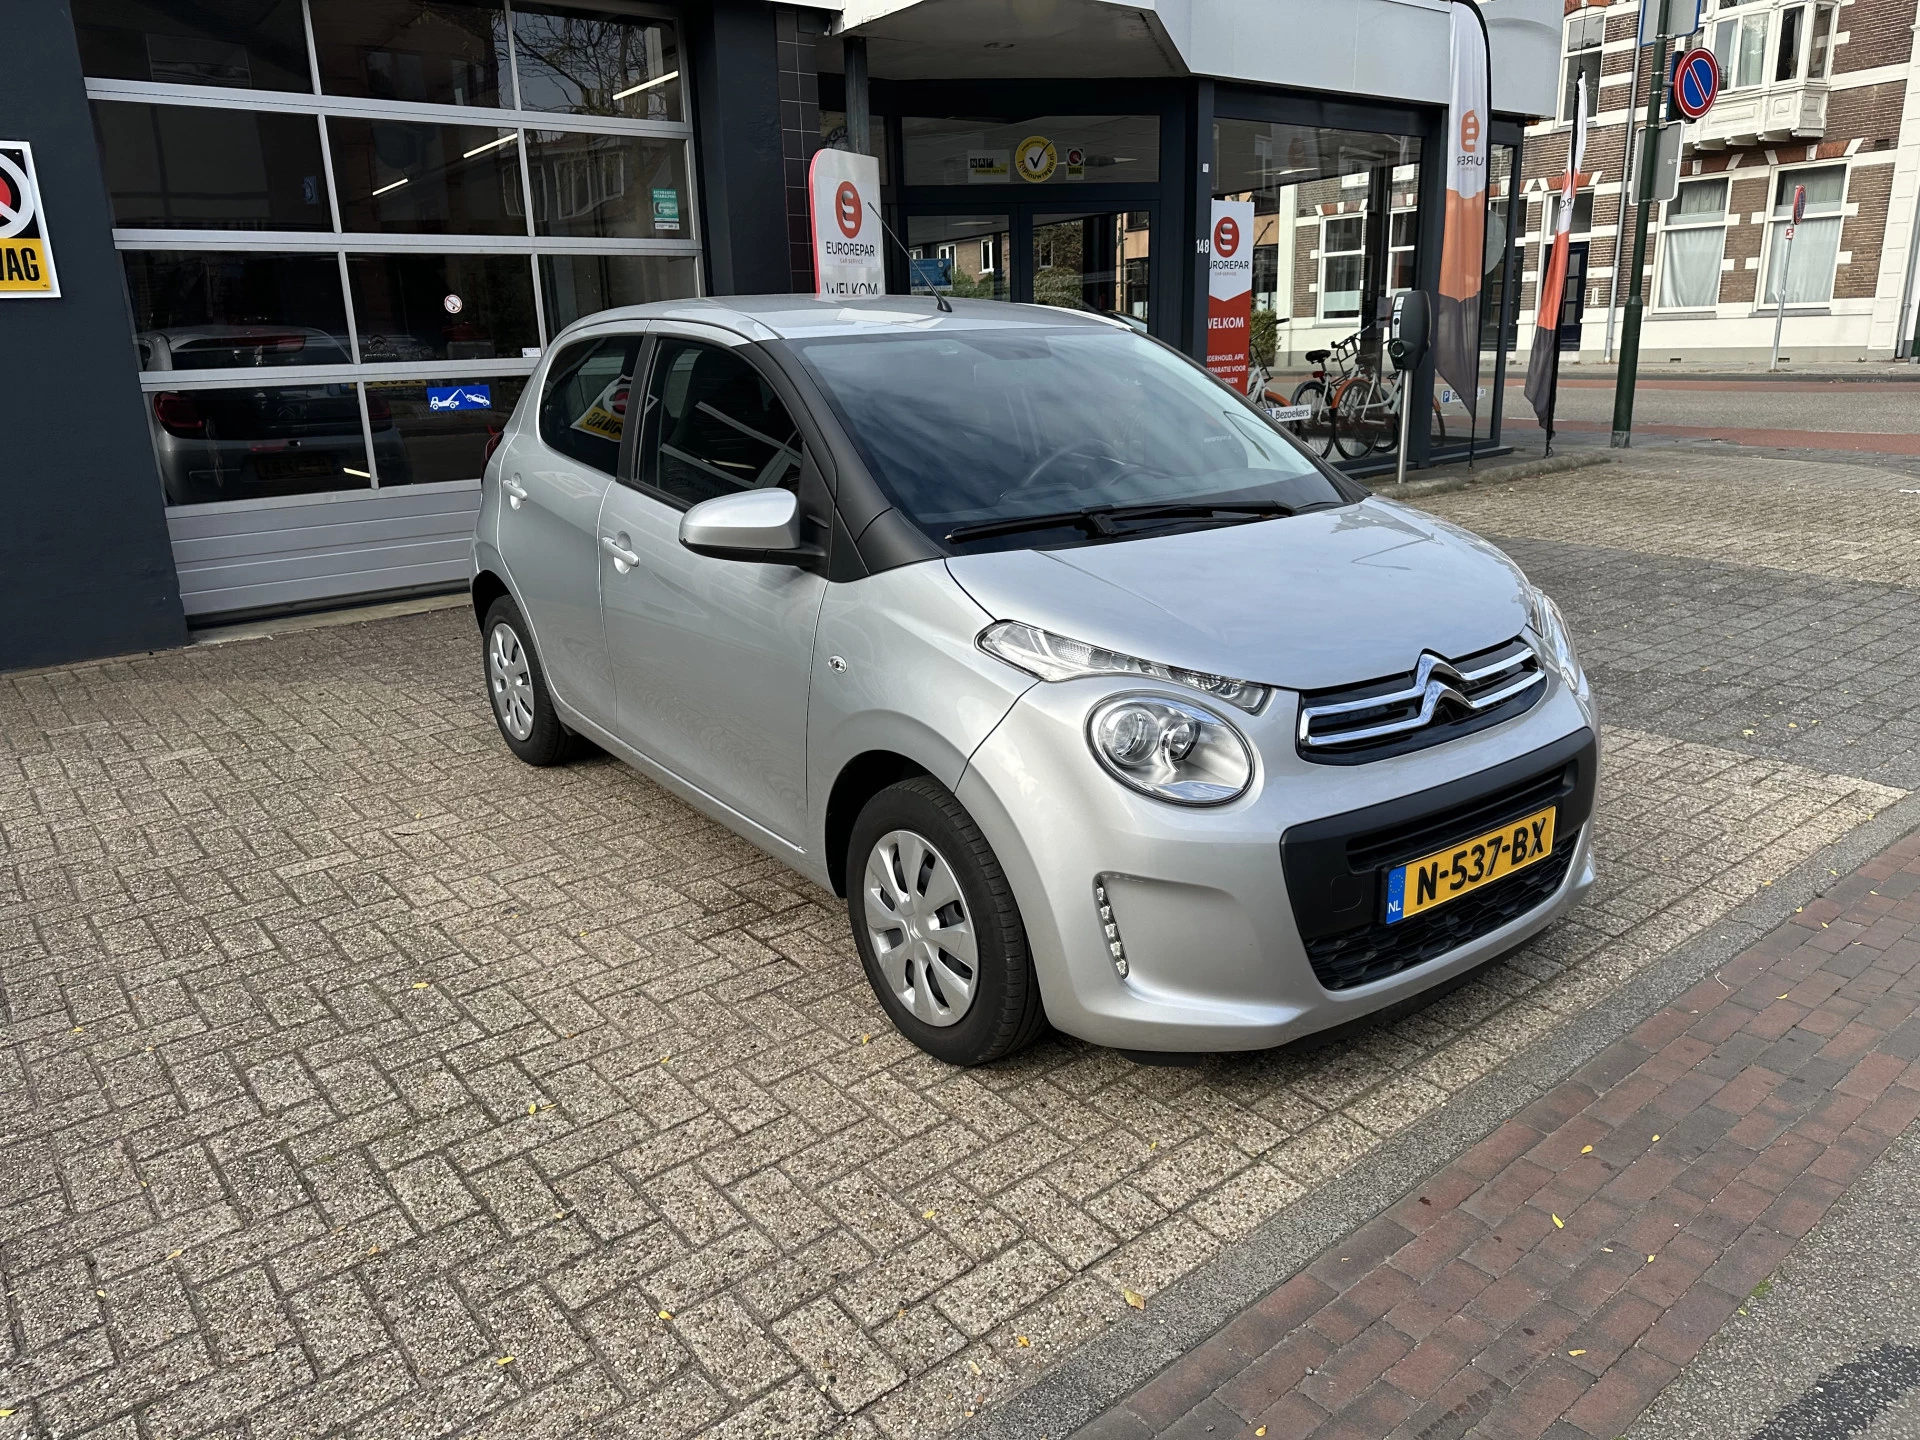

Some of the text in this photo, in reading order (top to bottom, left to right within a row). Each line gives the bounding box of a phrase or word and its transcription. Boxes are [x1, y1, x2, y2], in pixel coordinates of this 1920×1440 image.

[826, 241, 875, 257] EUROREPAR
[1196, 239, 1210, 254] 148
[1234, 353, 1245, 361] APK
[1232, 365, 1247, 373] VOOR
[1275, 408, 1310, 420] Bezoekers
[1416, 816, 1547, 906] N-537-BX
[1387, 899, 1402, 914] NL
